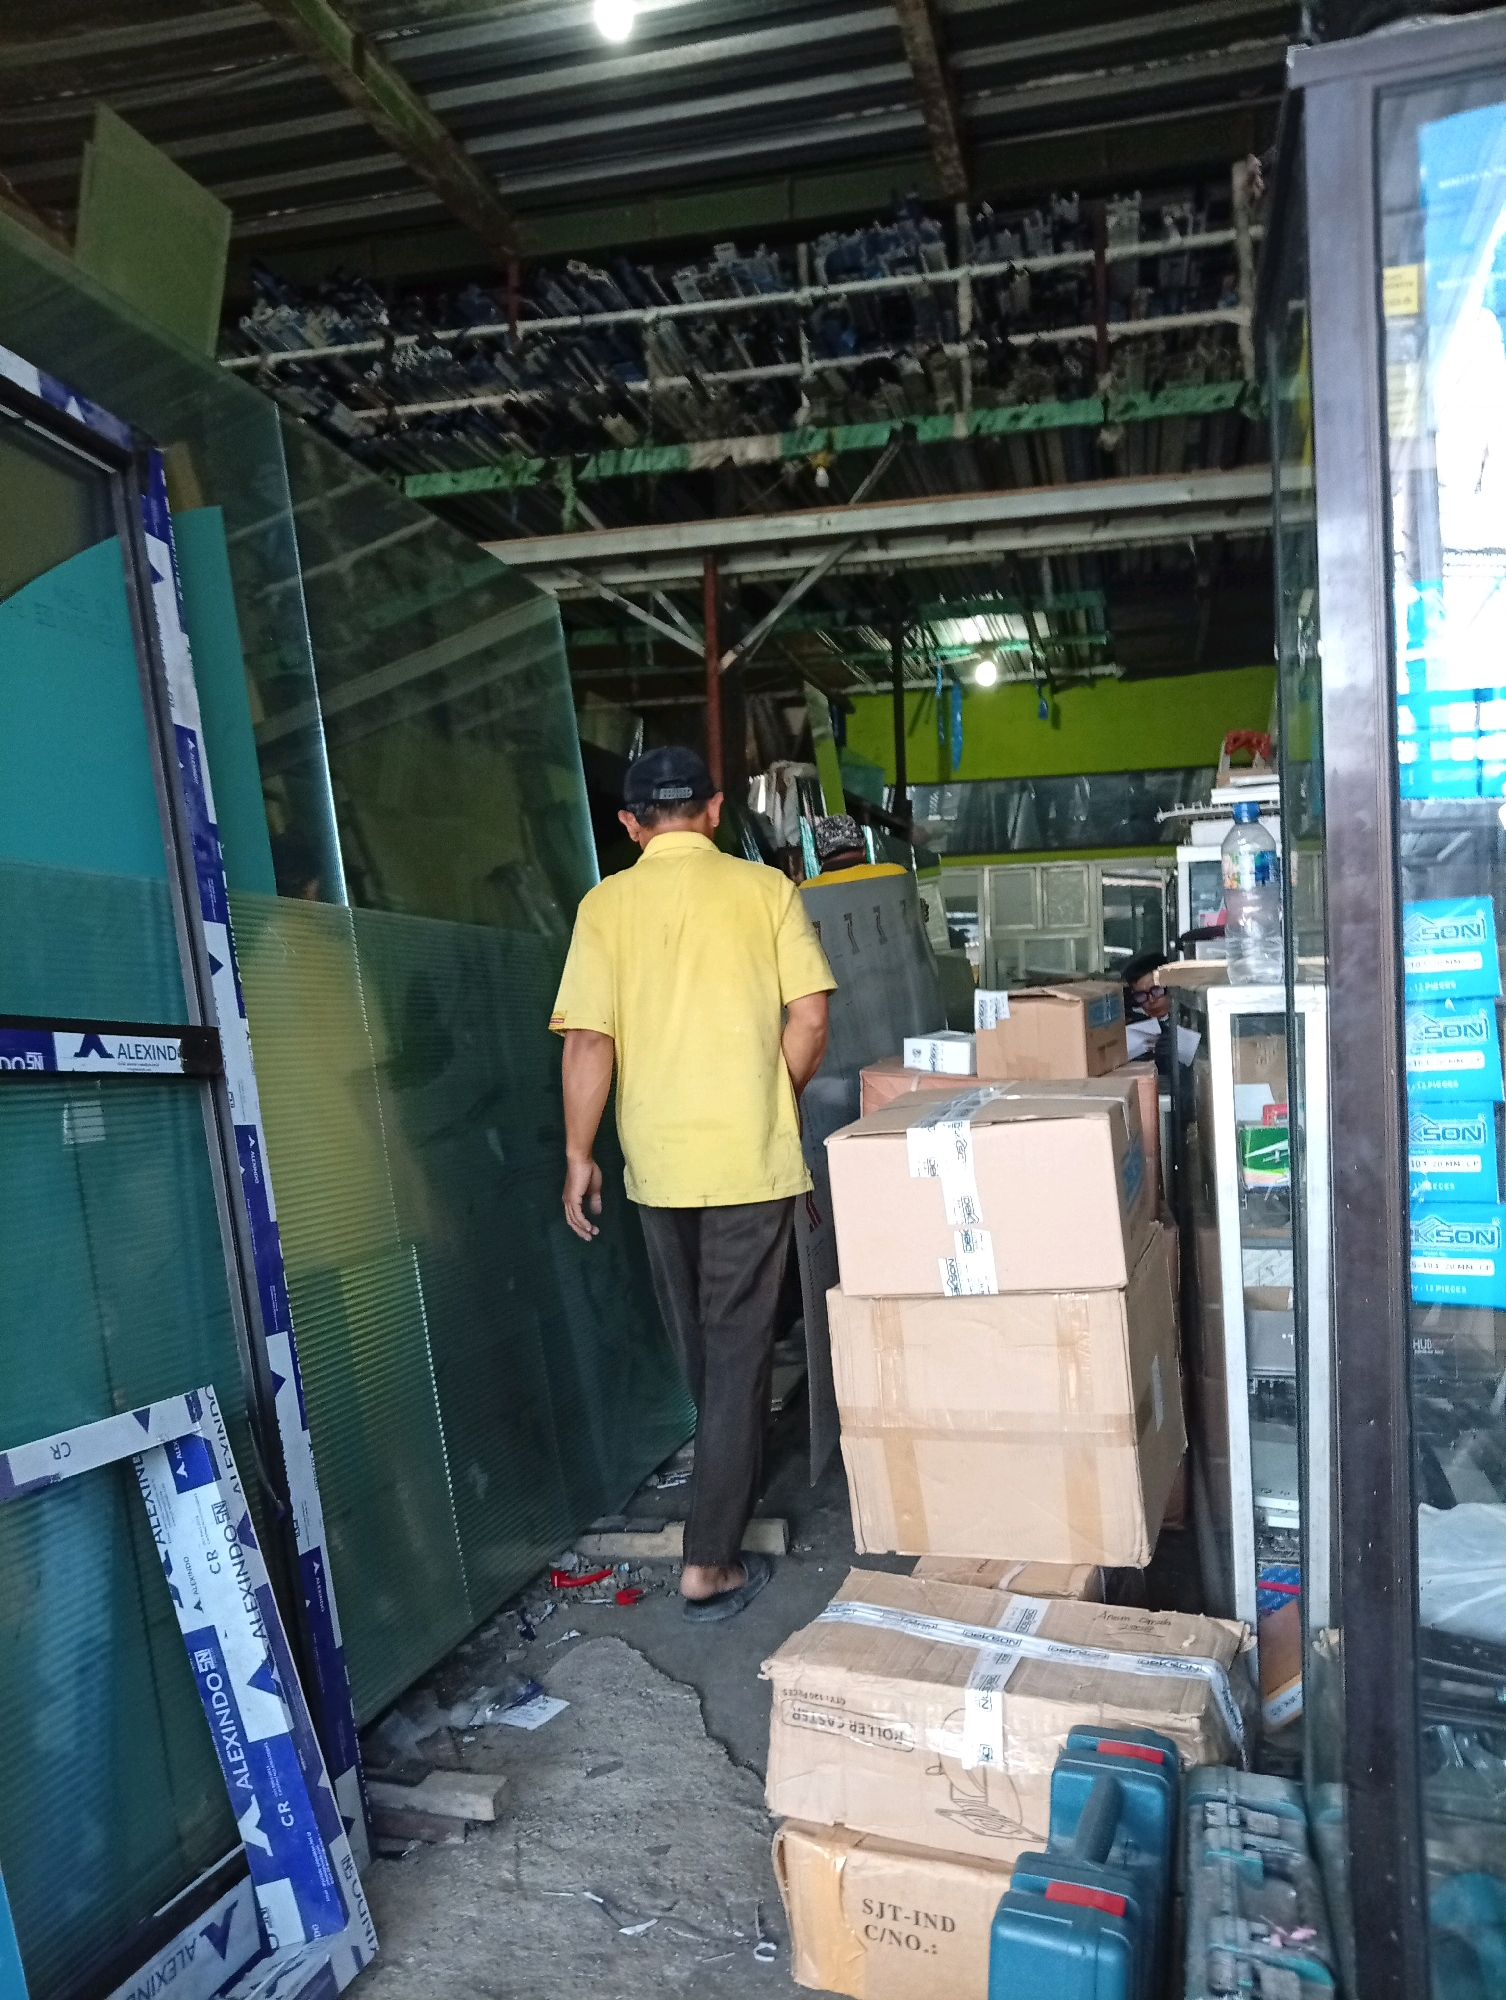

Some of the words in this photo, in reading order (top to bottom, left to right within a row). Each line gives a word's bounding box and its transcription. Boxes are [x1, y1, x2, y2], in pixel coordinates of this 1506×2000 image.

[117, 1042, 182, 1061] ALEXIND
[50, 1442, 71, 1460] CR
[206, 1549, 221, 1575] CR
[223, 1525, 268, 1639] ALEXINDO
[206, 1672, 254, 1790] ALEXINDO
[278, 1800, 294, 1827] CR
[862, 1898, 955, 1933] SJT-IND
